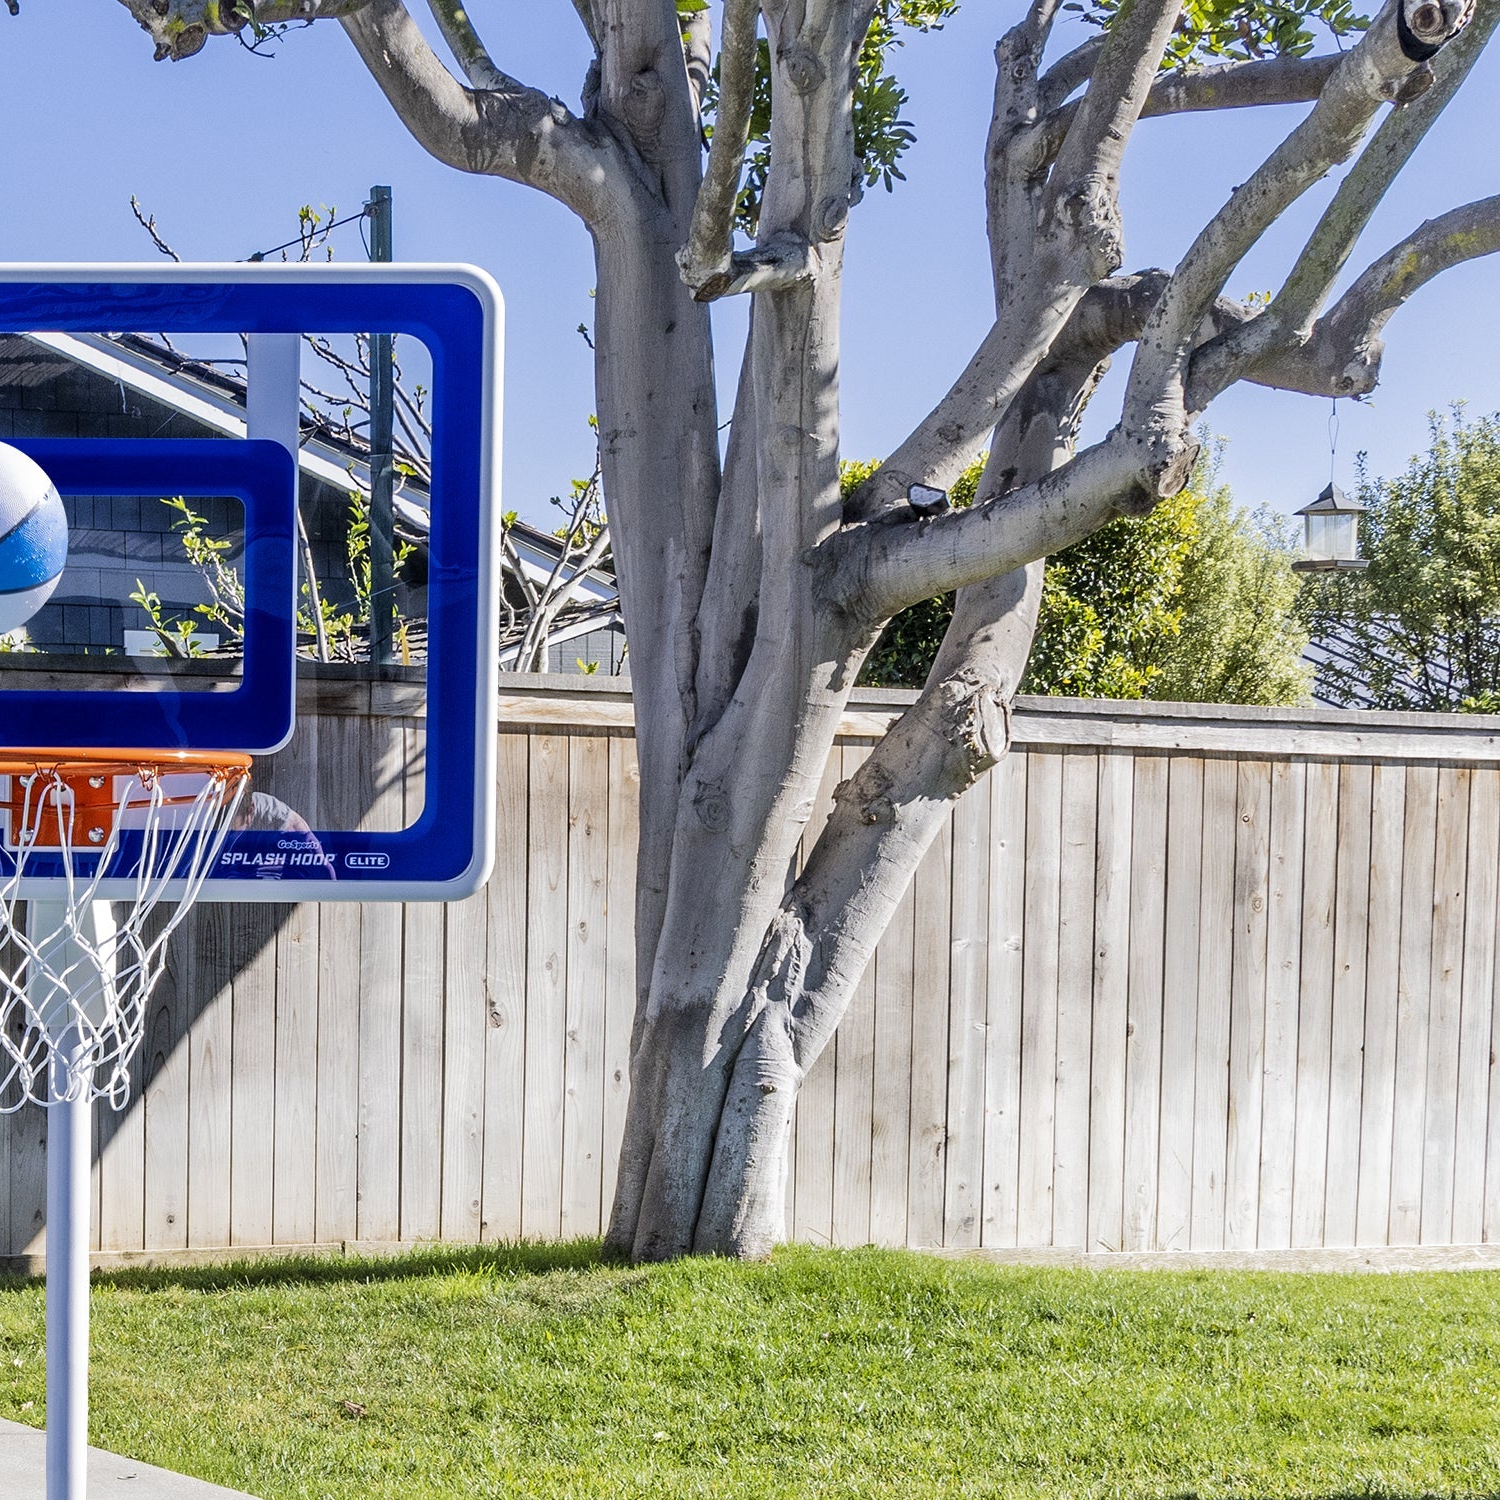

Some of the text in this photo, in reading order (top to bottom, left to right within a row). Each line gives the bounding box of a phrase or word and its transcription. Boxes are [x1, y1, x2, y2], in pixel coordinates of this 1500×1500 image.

[277, 839, 320, 850] GoSports
[221, 852, 385, 866] SPLASH HOOP ELITE
